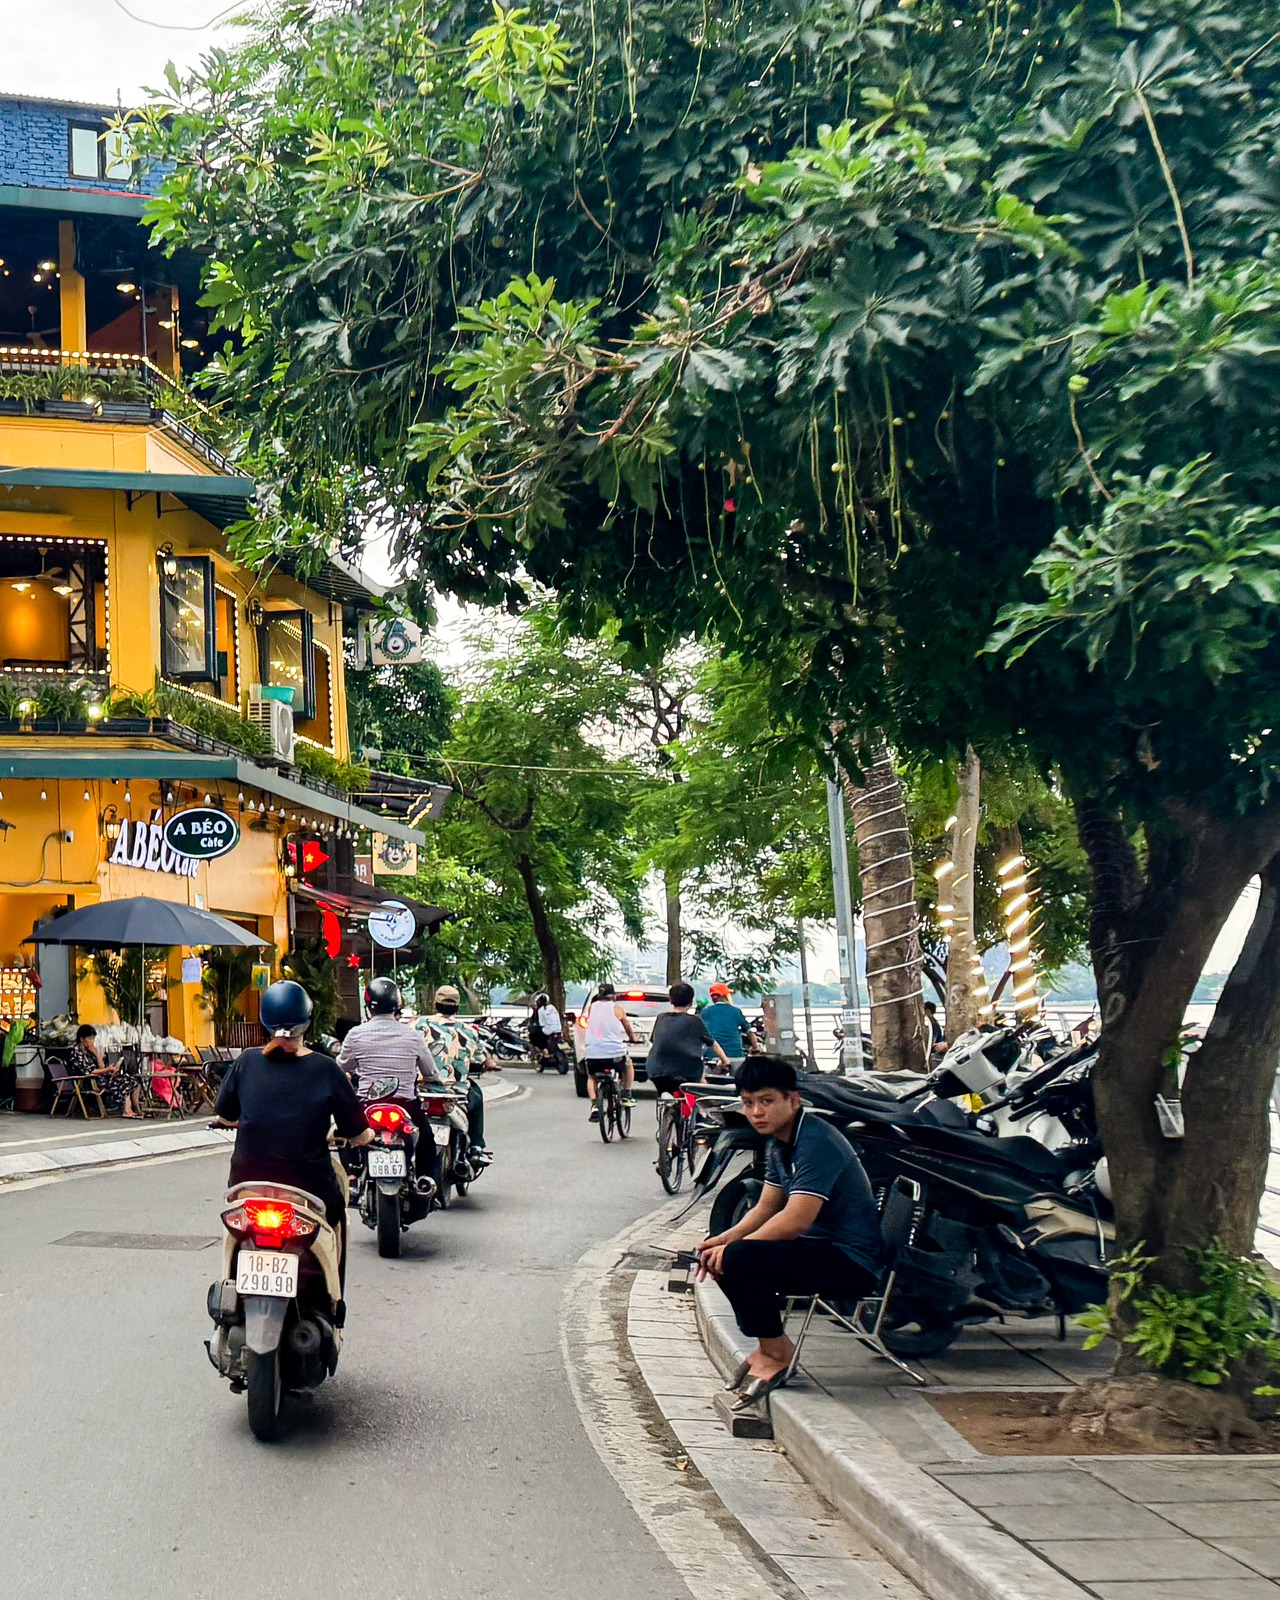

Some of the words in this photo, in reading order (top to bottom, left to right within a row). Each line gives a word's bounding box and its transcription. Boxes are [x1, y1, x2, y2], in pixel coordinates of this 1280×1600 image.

[173, 822, 187, 836] A
[191, 818, 227, 835] BÉO
[240, 1273, 294, 1294] 298.98
